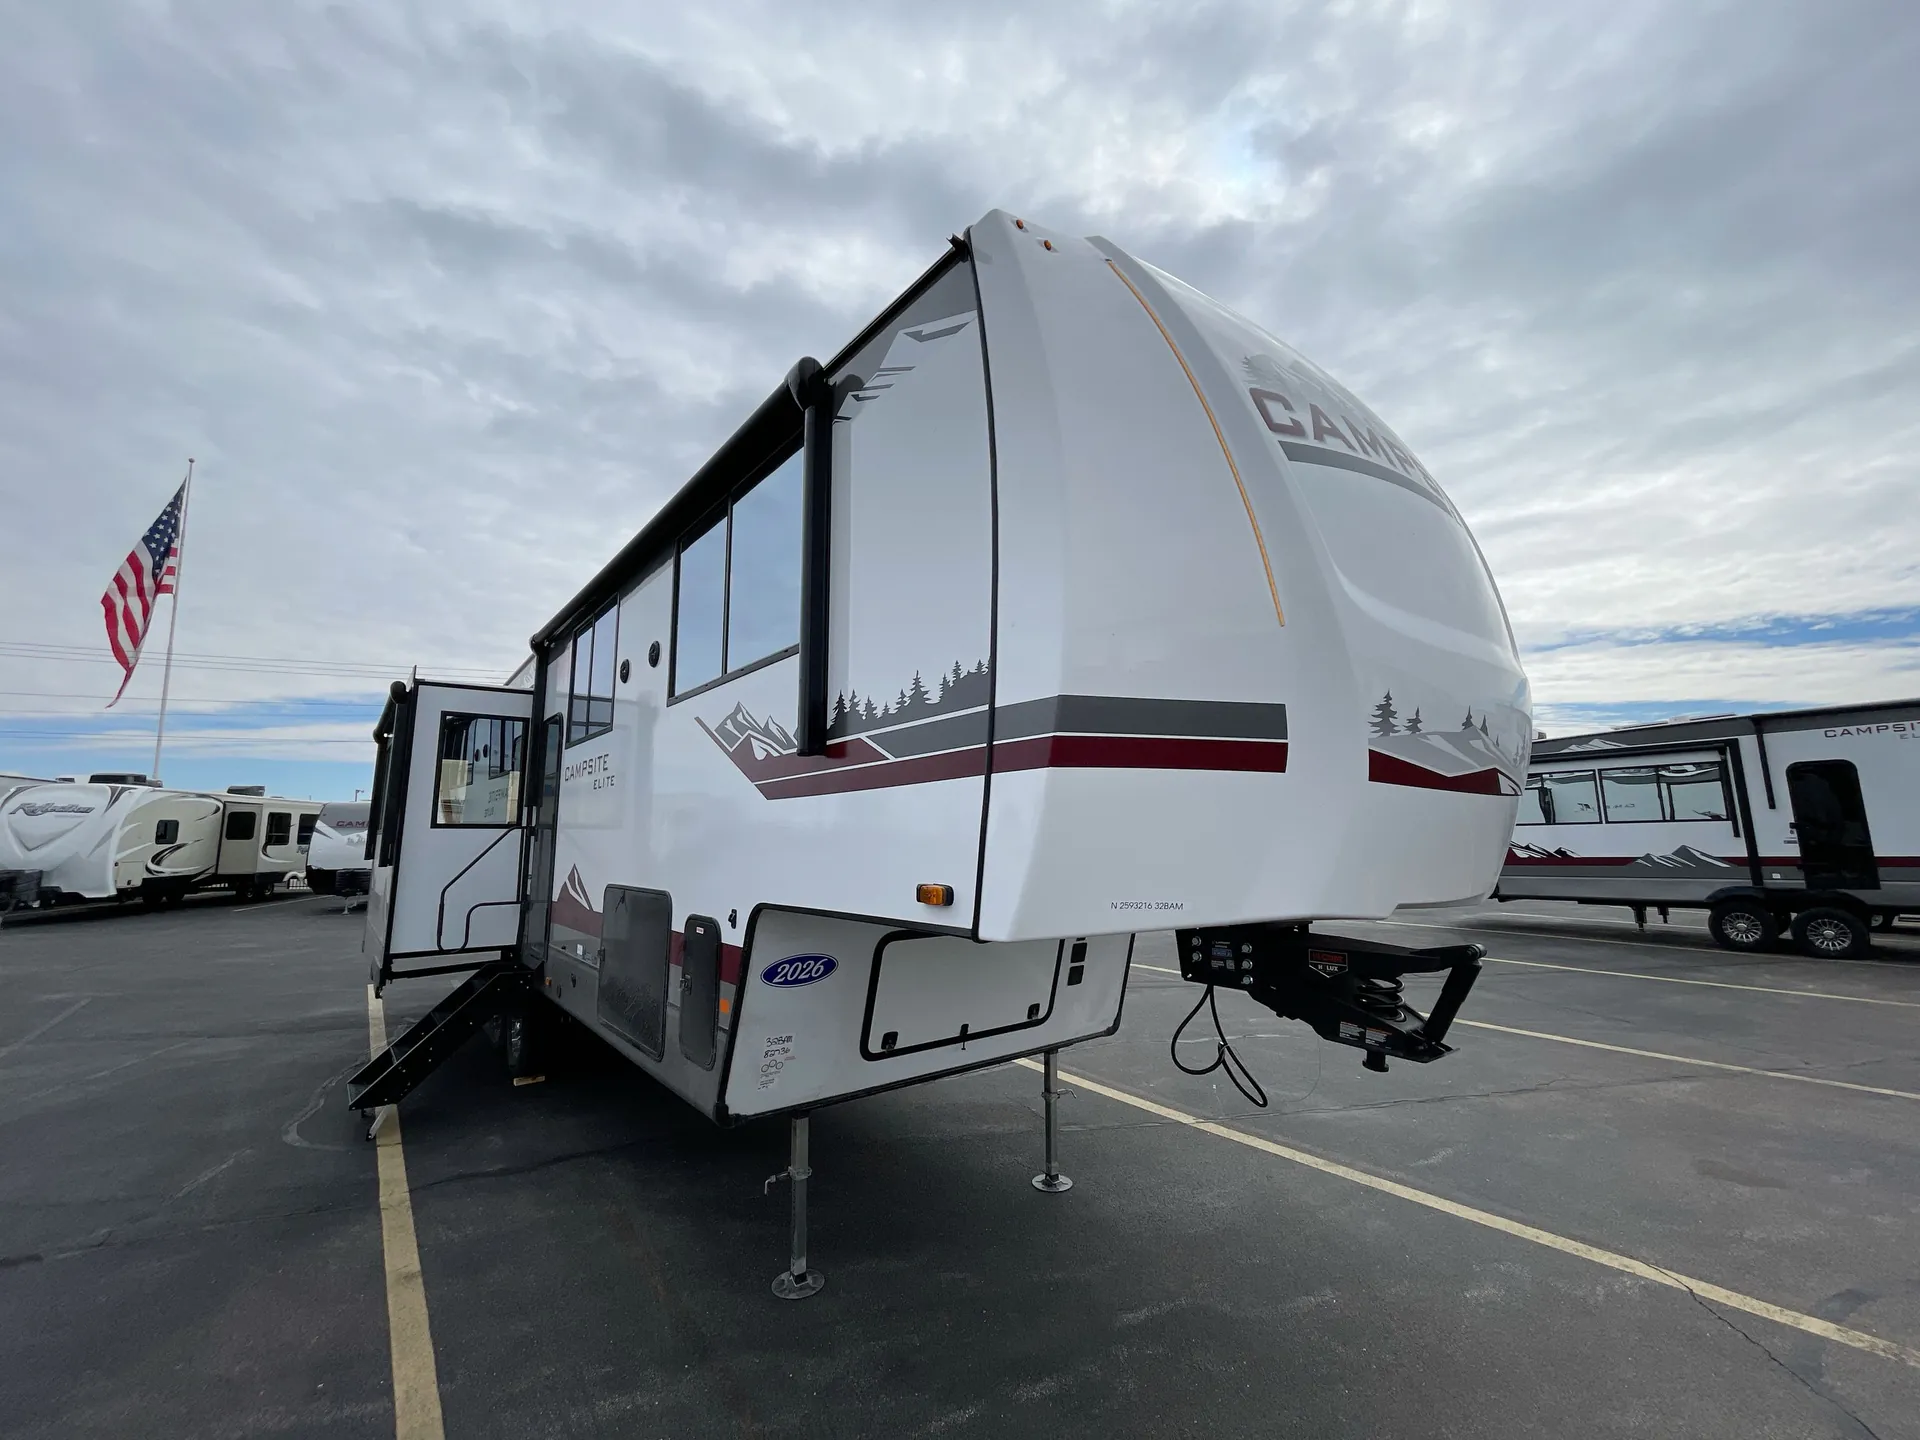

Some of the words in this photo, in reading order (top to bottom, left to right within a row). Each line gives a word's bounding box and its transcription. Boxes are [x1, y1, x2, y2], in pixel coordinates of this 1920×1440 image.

[564, 753, 609, 782] CAMPSITE
[593, 775, 615, 790] ELITE
[1110, 901, 1118, 910] N
[1119, 901, 1153, 910] 2593216
[772, 958, 828, 983] 2026
